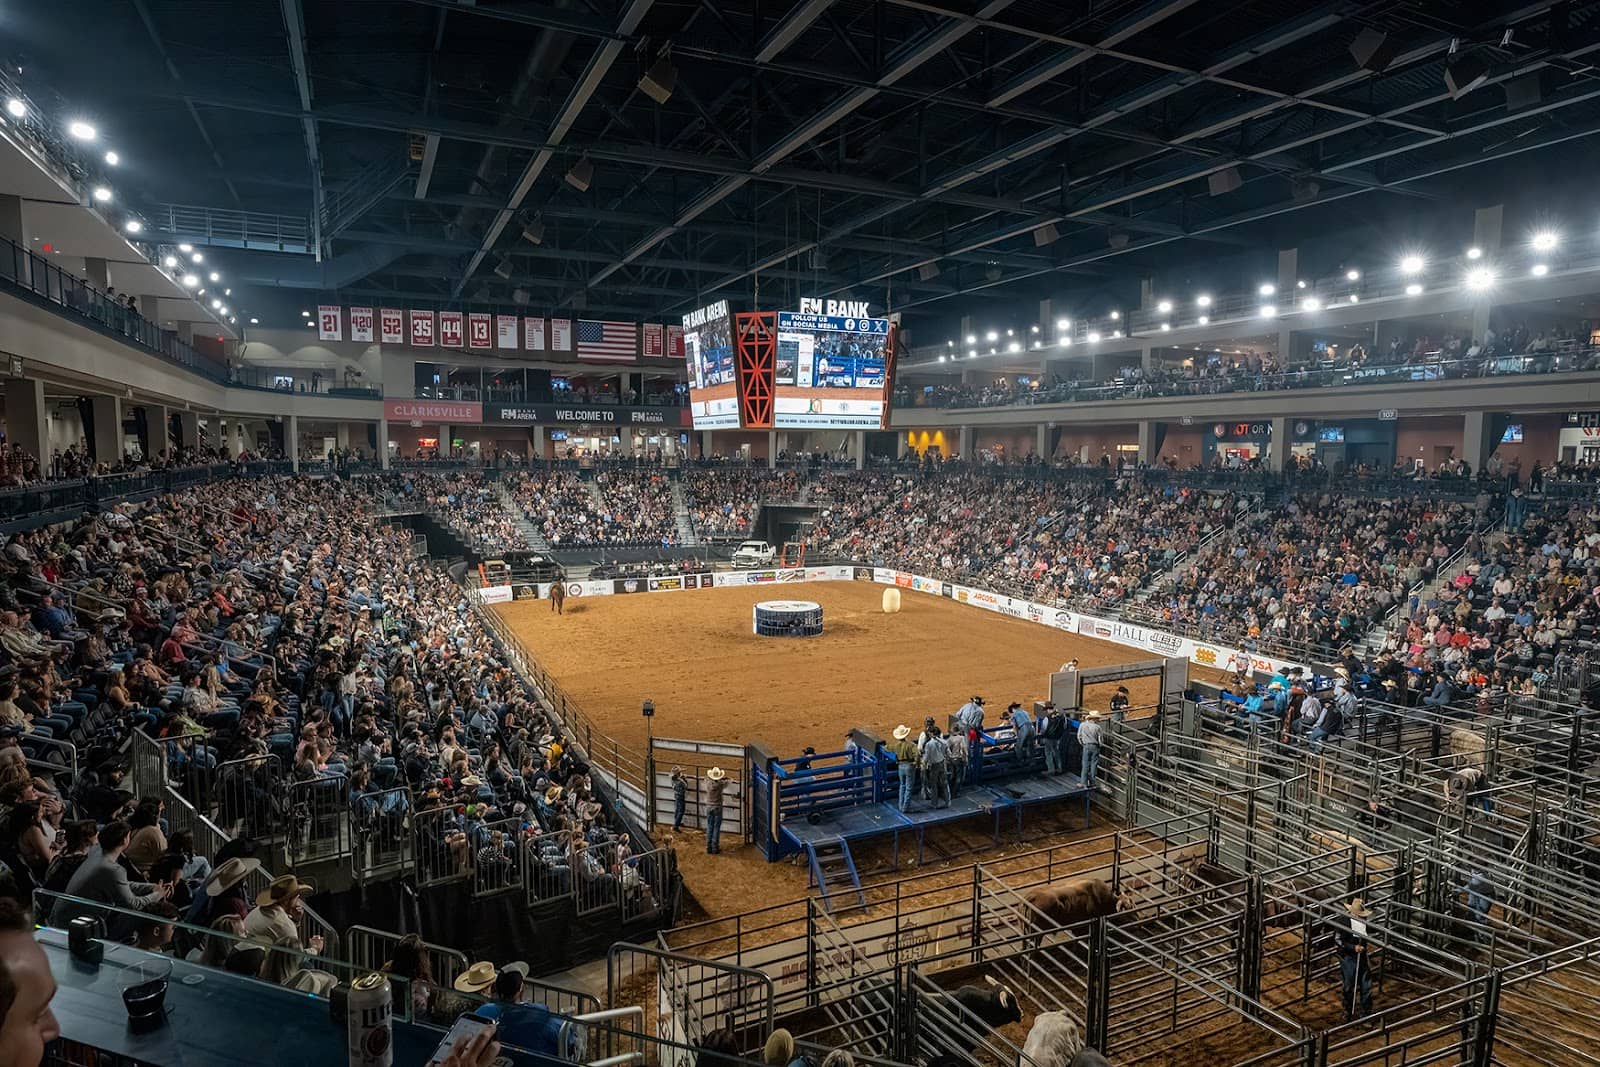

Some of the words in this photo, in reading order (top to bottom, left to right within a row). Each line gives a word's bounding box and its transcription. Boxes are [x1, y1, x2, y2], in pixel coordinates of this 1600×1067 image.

[690, 307, 707, 328] BANK
[706, 299, 728, 322] ARENA
[827, 299, 870, 319] BANK
[323, 315, 338, 332] 21
[352, 316, 372, 329] 420
[383, 317, 401, 335] 52
[413, 319, 432, 337] 35
[442, 320, 461, 338] 44
[473, 321, 488, 339] 13
[394, 406, 473, 418] CLARKSVILLE
[555, 410, 601, 421] WELCOME
[602, 411, 614, 421] TO
[1252, 424, 1264, 435] OR
[1113, 623, 1146, 642] HALL
